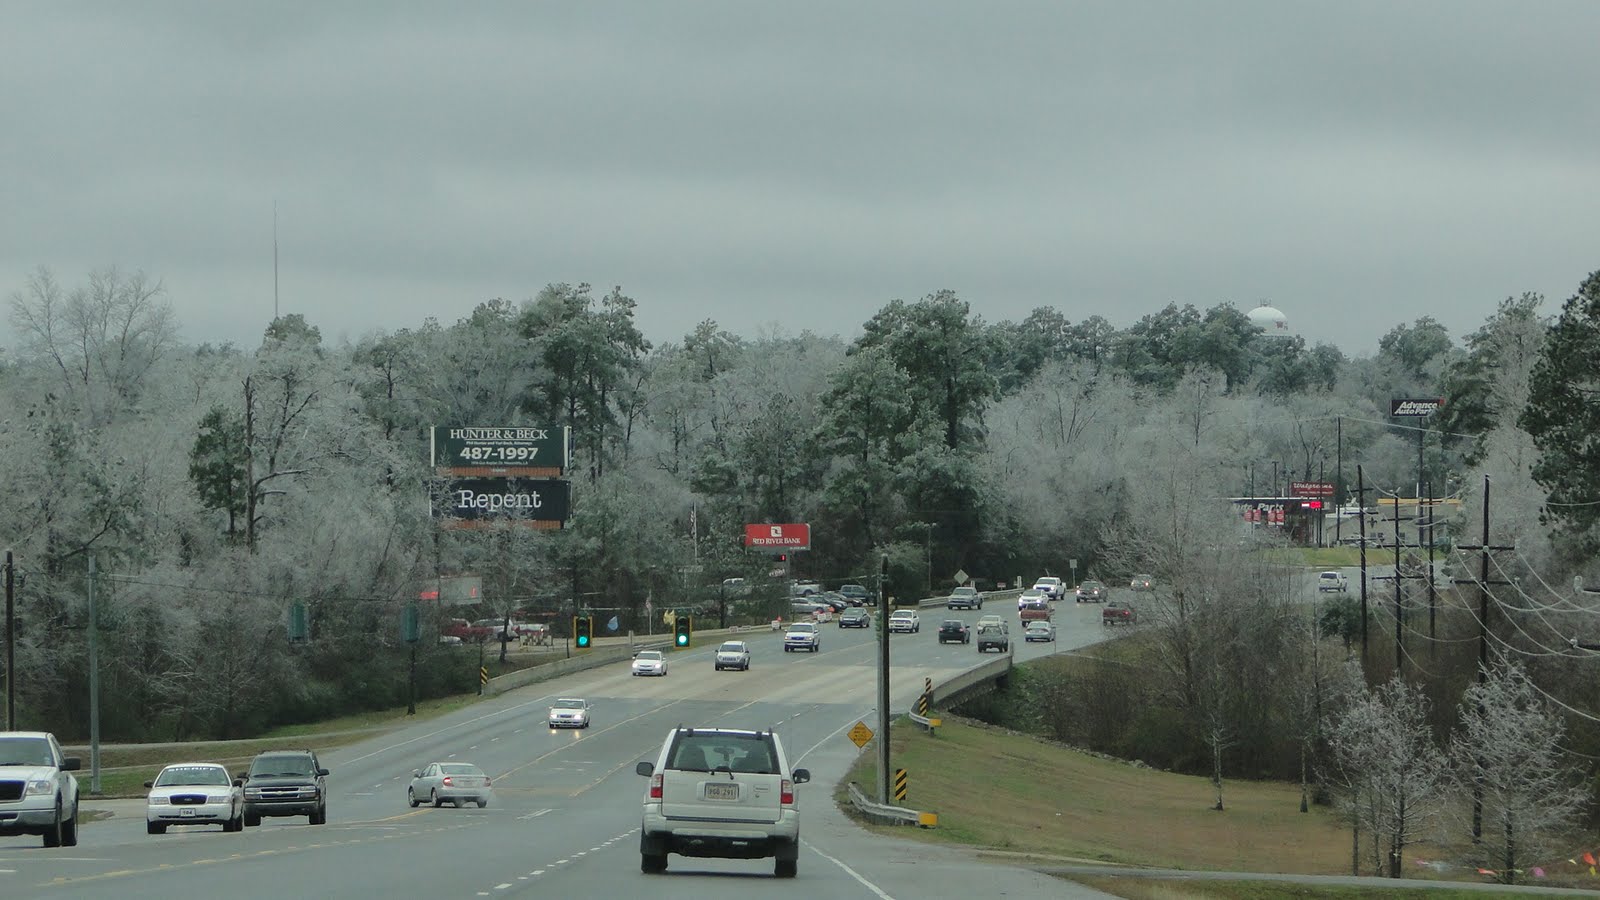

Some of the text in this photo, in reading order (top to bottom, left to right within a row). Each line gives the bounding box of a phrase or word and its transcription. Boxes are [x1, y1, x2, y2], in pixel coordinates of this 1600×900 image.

[1399, 401, 1438, 409] Advance
[450, 429, 548, 439] HUNTER & BECK
[460, 447, 539, 460] 487-1997
[458, 489, 542, 512] Repent
